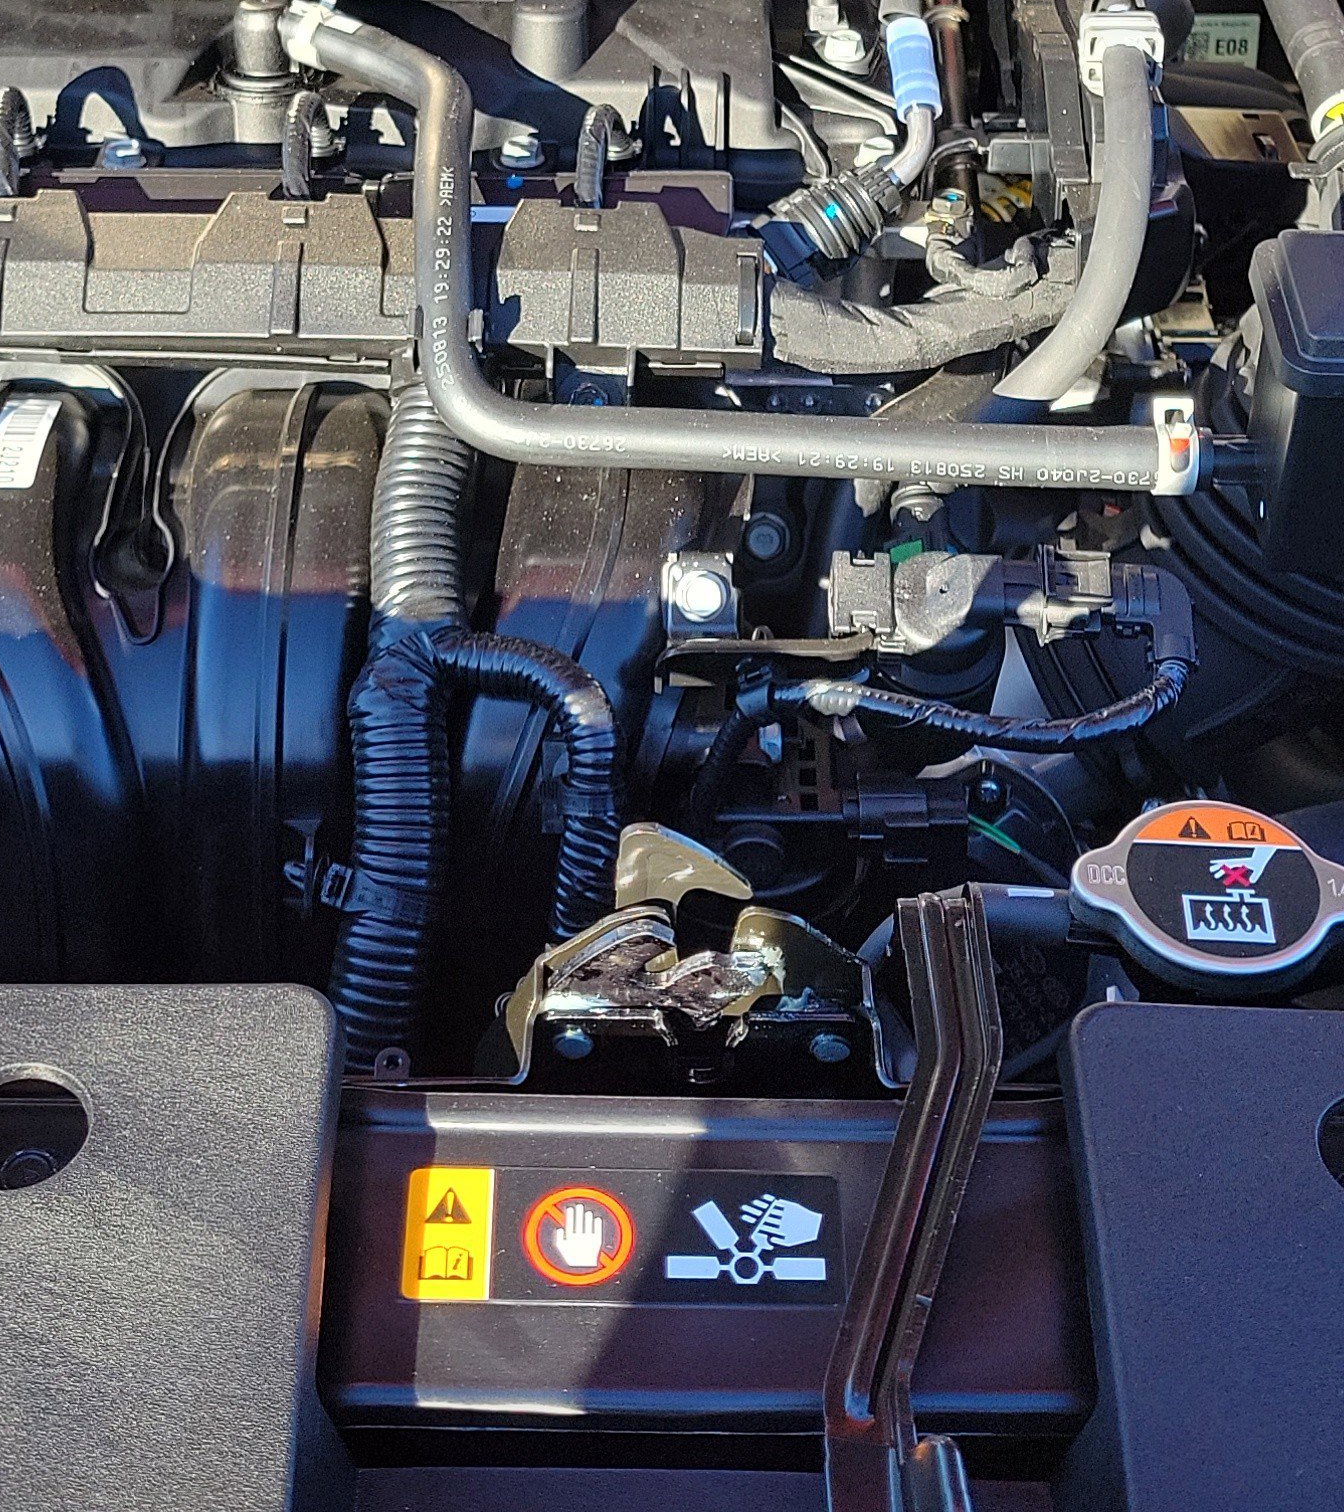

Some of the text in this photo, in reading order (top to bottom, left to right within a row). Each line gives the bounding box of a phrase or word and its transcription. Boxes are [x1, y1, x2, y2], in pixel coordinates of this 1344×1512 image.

[1215, 38, 1248, 56] E08
[432, 165, 455, 391] 250813 19:29:22 >AEM<
[721, 447, 782, 463] >AEM<
[796, 450, 895, 472] 19:29:21
[909, 459, 986, 479] 250813
[998, 466, 1025, 482] HS
[1086, 863, 1127, 886] DCC
